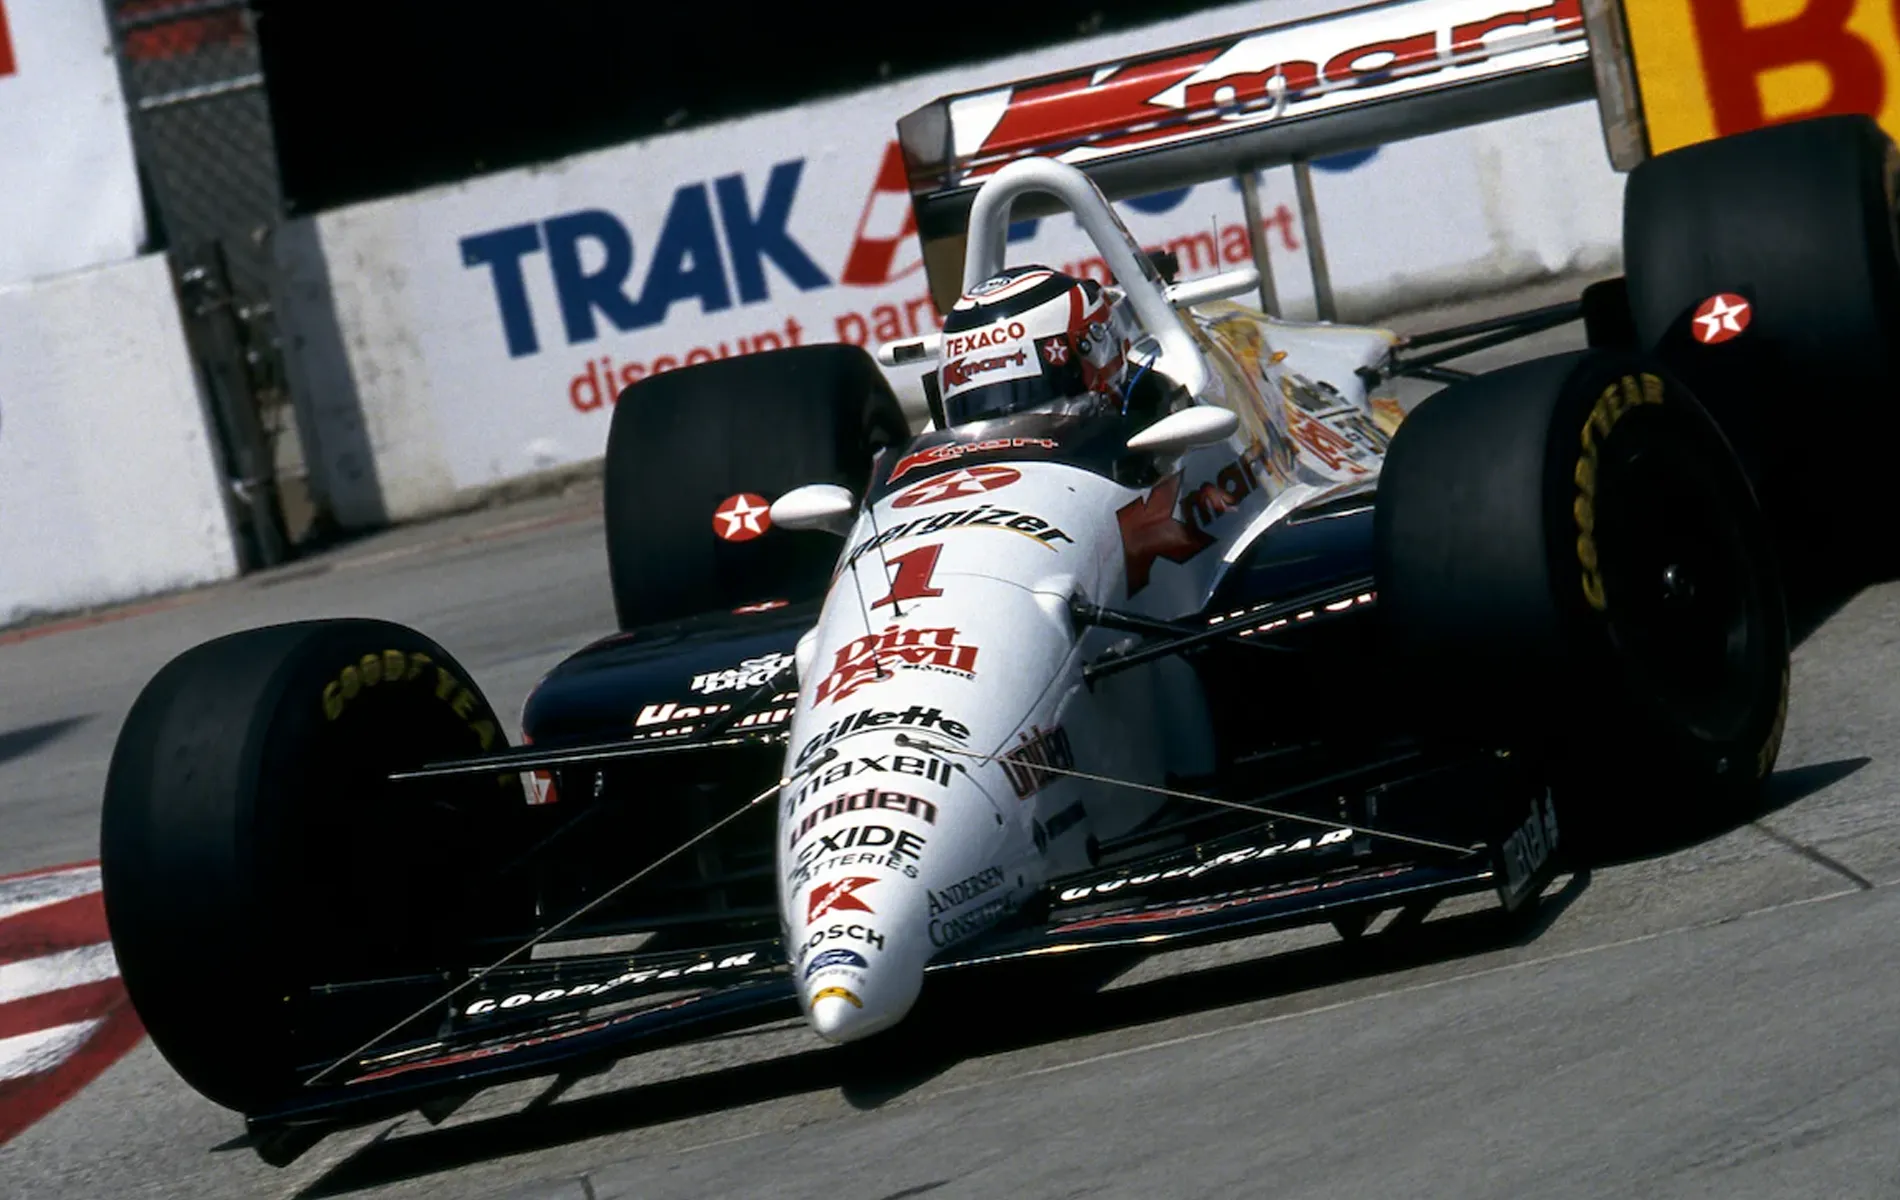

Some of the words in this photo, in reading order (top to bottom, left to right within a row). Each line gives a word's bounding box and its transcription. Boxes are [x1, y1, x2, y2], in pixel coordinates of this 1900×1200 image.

[459, 157, 834, 358] TRAK
[944, 349, 1028, 393] Kmart
[946, 322, 1026, 359] TEXACO
[846, 504, 1076, 564] nergizer
[1116, 447, 1267, 600] Kmar
[870, 543, 944, 611] 1
[812, 646, 980, 710] Devil
[832, 624, 961, 674] Dirt
[322, 649, 497, 752] GOODYEA
[795, 705, 971, 769] Gillette
[788, 755, 951, 817] maxell
[790, 787, 939, 851] uniden
[793, 825, 926, 868] EXIDE
[927, 865, 1006, 918] ANDERSEN
